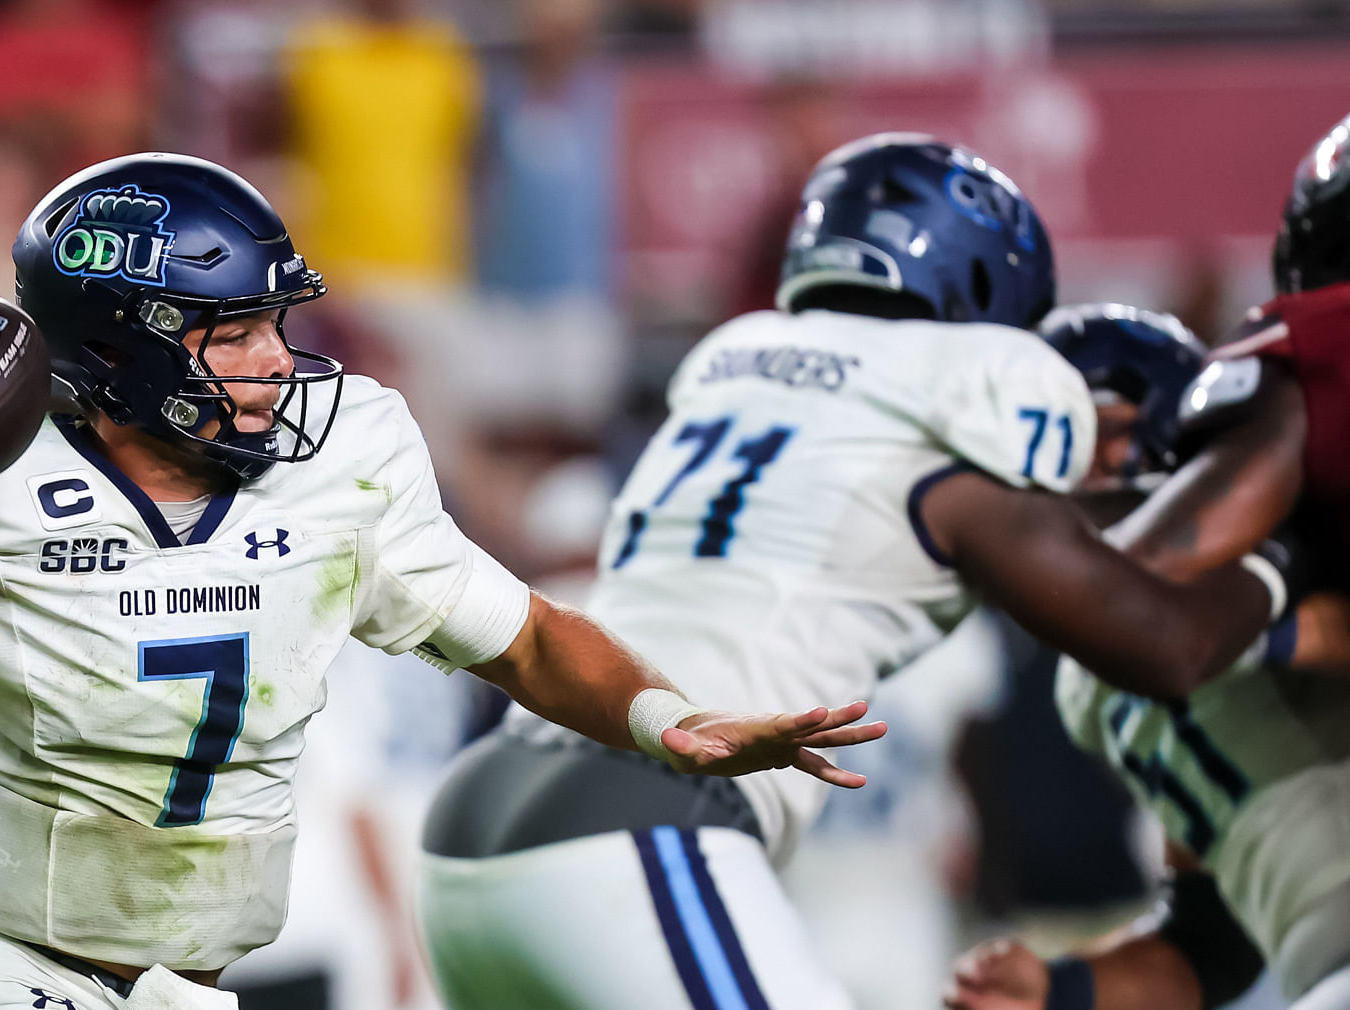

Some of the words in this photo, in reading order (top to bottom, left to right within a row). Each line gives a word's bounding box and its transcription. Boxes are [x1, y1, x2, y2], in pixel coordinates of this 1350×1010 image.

[58, 228, 165, 279] ODU
[1018, 409, 1072, 480] 71
[37, 478, 95, 519] C
[612, 416, 795, 570] 71
[39, 537, 128, 574] SBC
[119, 590, 156, 617] OLD
[166, 584, 261, 614] DOMINION
[137, 631, 250, 828] 7
